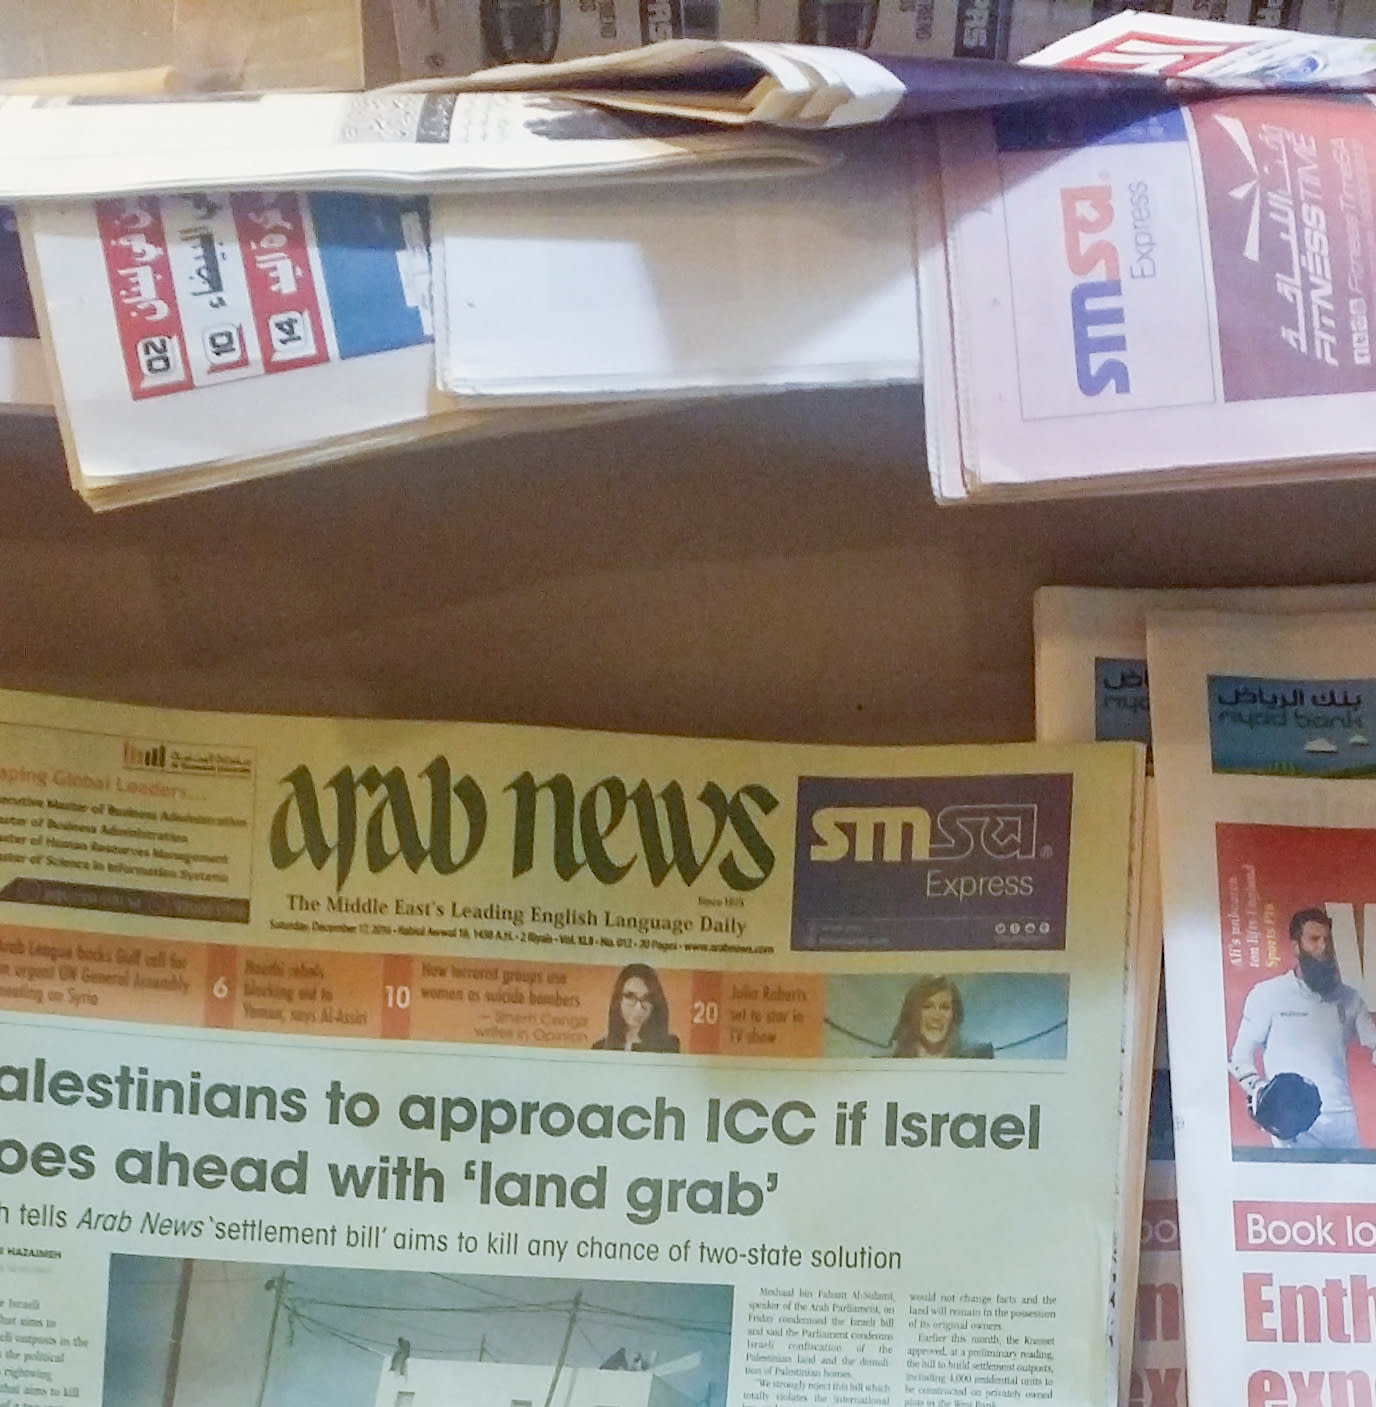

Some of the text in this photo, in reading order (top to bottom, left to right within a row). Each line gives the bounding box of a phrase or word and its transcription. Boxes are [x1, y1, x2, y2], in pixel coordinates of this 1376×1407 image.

[1129, 181, 1157, 279] Express
[275, 318, 301, 344] 14
[270, 753, 780, 894] arab news
[927, 869, 1034, 901] Express
[287, 894, 321, 913] The
[327, 896, 390, 917] Middle
[450, 902, 524, 930] Leading
[529, 905, 598, 931] English
[604, 910, 694, 935] Language
[700, 913, 747, 936] Daily
[213, 978, 228, 999] 6
[384, 985, 411, 1009] 10
[692, 1001, 718, 1026] 20
[327, 1080, 380, 1129] to
[398, 1093, 686, 1143] approach
[706, 1097, 816, 1145] ICC
[834, 1101, 867, 1148] if
[884, 1102, 1041, 1151] Israel
[115, 1140, 309, 1196] ahead
[327, 1152, 445, 1204] with
[19, 1202, 68, 1229] tells
[77, 1206, 132, 1234] Arab
[140, 1211, 204, 1239] News
[393, 1228, 448, 1253] aims
[457, 1231, 479, 1254] to
[485, 1230, 519, 1257] kill
[527, 1238, 568, 1262] any
[576, 1235, 659, 1262] chance
[668, 1238, 692, 1264] of
[699, 1240, 803, 1268] two-state
[811, 1244, 902, 1270] solution
[1246, 1213, 1338, 1248] Book
